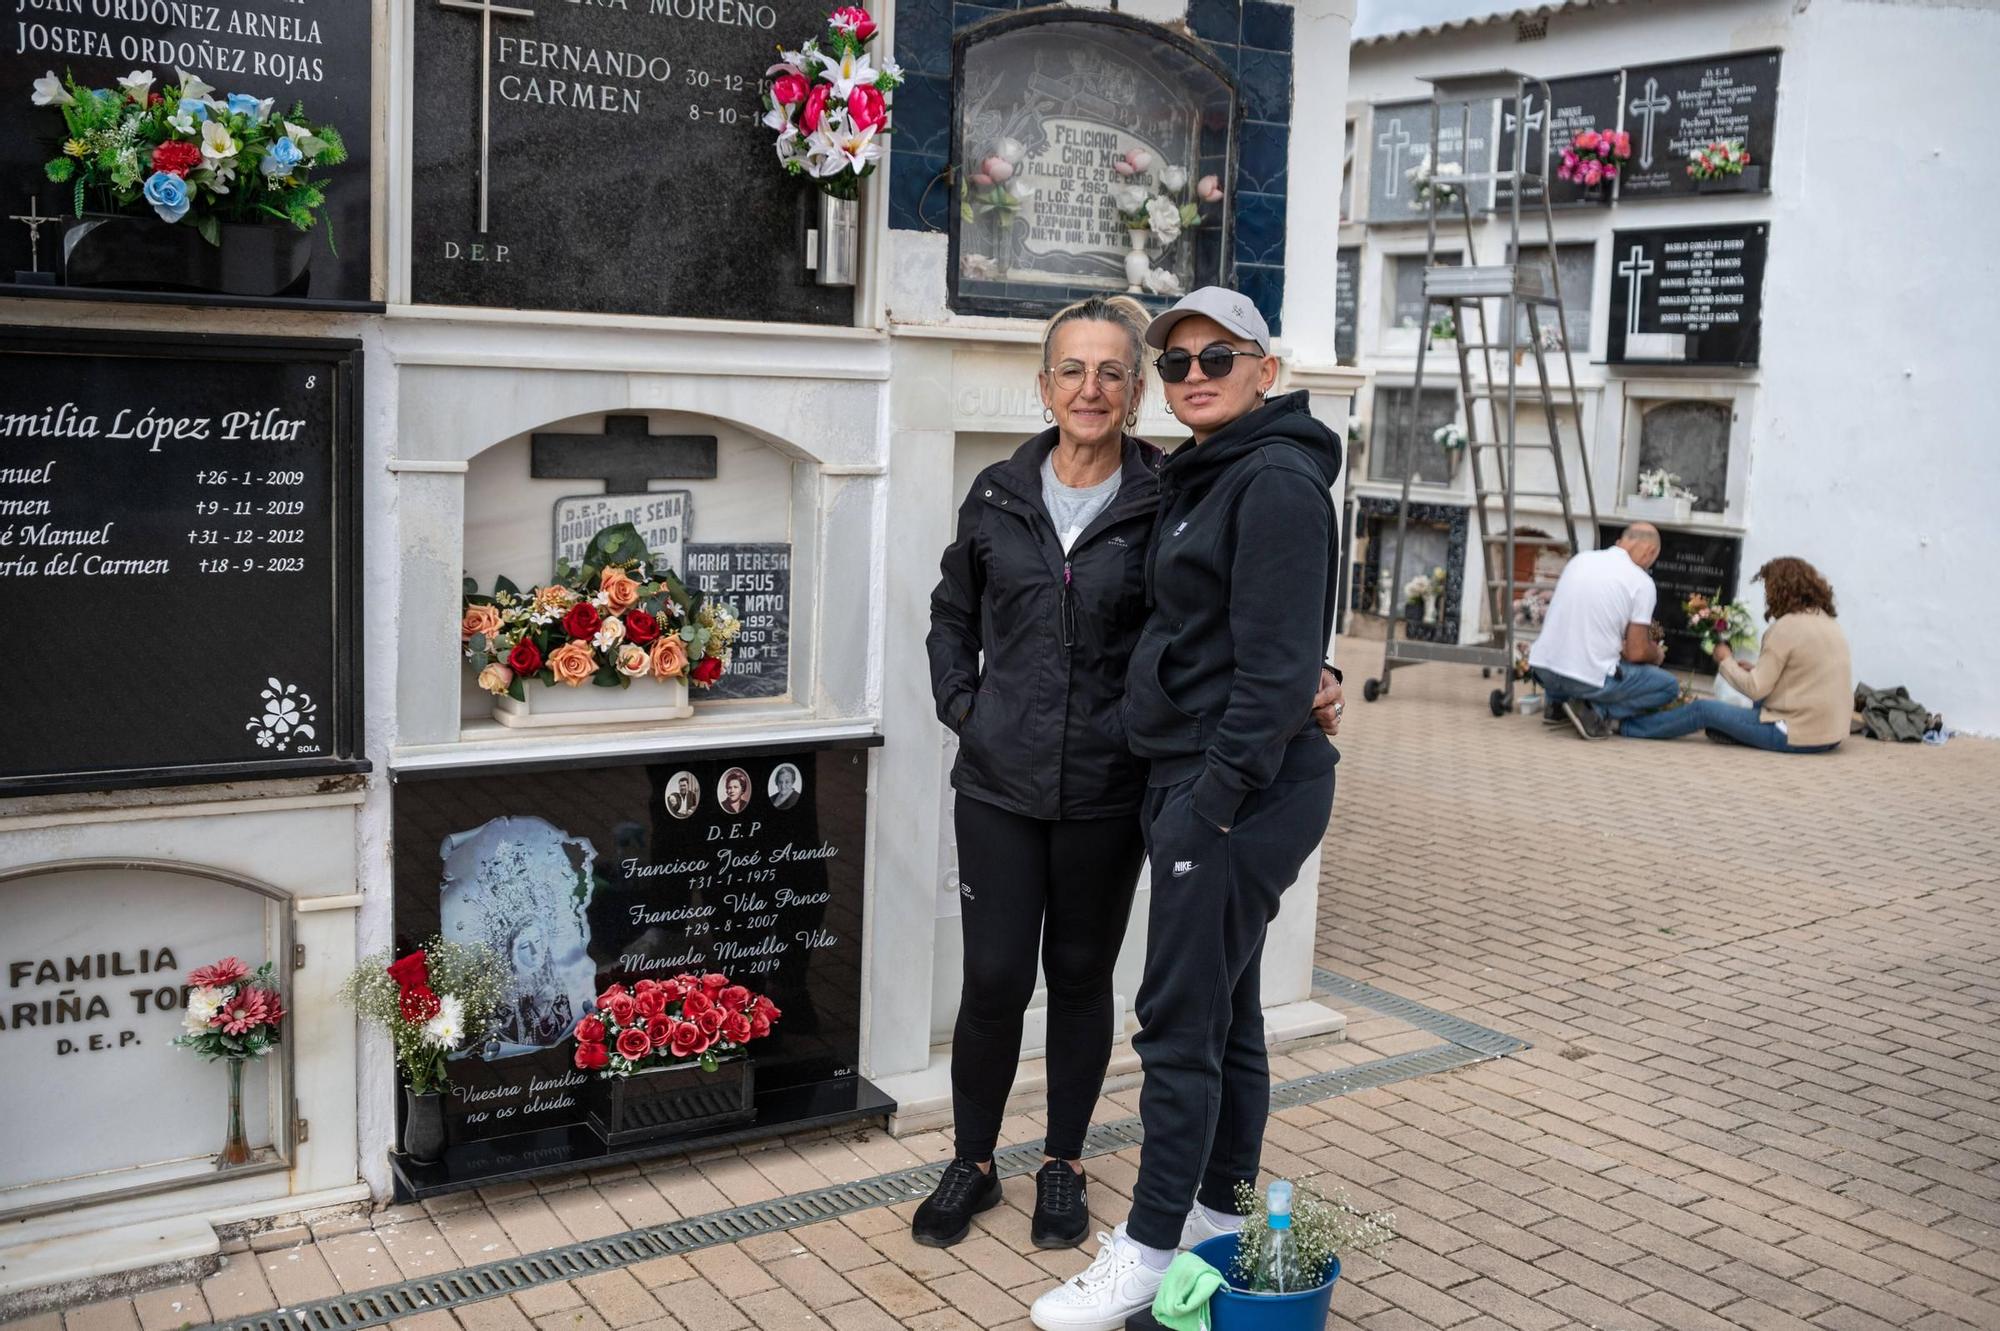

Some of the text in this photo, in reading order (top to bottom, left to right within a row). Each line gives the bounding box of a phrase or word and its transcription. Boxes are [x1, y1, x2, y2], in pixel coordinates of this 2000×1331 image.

[649, 0, 777, 29] MORENO
[227, 9, 323, 44] ARNELA
[16, 21, 323, 85] JOSEFA ORDOÑEZ ROJAS
[498, 36, 671, 82] FERNANDO
[499, 75, 641, 114] CARMEN
[1055, 124, 1118, 150] FELICIANA
[1062, 145, 1093, 167] CIRIA
[1077, 167, 1088, 180] EL
[1093, 169, 1105, 182] 29
[1109, 171, 1121, 184] DE
[1060, 179, 1109, 195] DE 1963
[1034, 189, 1042, 201] A
[1048, 190, 1070, 204] LOS
[1076, 194, 1094, 206] 44
[1099, 207, 1113, 221] DE
[1105, 233, 1118, 247] TE
[305, 376, 316, 389] 8
[105, 407, 210, 451] López
[221, 407, 306, 441] Pilar
[0, 461, 56, 483] nuel
[0, 499, 51, 516] men
[625, 507, 642, 526] DE
[647, 497, 681, 522] SENA
[19, 522, 115, 546] Manuel
[0, 554, 38, 576] ría
[43, 552, 83, 576] del
[83, 555, 170, 576] Carmen
[688, 553, 788, 571] MARIA TERESA
[699, 574, 774, 592] DE JESUS
[745, 594, 784, 612] MAYO
[740, 616, 774, 628] -1992
[732, 631, 765, 643] POSO
[739, 647, 756, 659] NO
[760, 646, 778, 658] TE
[726, 662, 762, 675] VIDAN
[297, 745, 320, 753] SOLA
[621, 840, 839, 880] Francisco José Aranda
[1174, 860, 1192, 872] NIKE
[629, 888, 831, 926] Francisca Vila Ponce
[619, 928, 838, 973] Manuela Murillo Vila
[9, 946, 178, 989] FAMILIA
[0, 988, 110, 1031] RIÑA
[833, 1068, 851, 1077] SOLA
[453, 1069, 588, 1104] Vuestra familia
[467, 1112, 489, 1124] no
[496, 1106, 516, 1119] os
